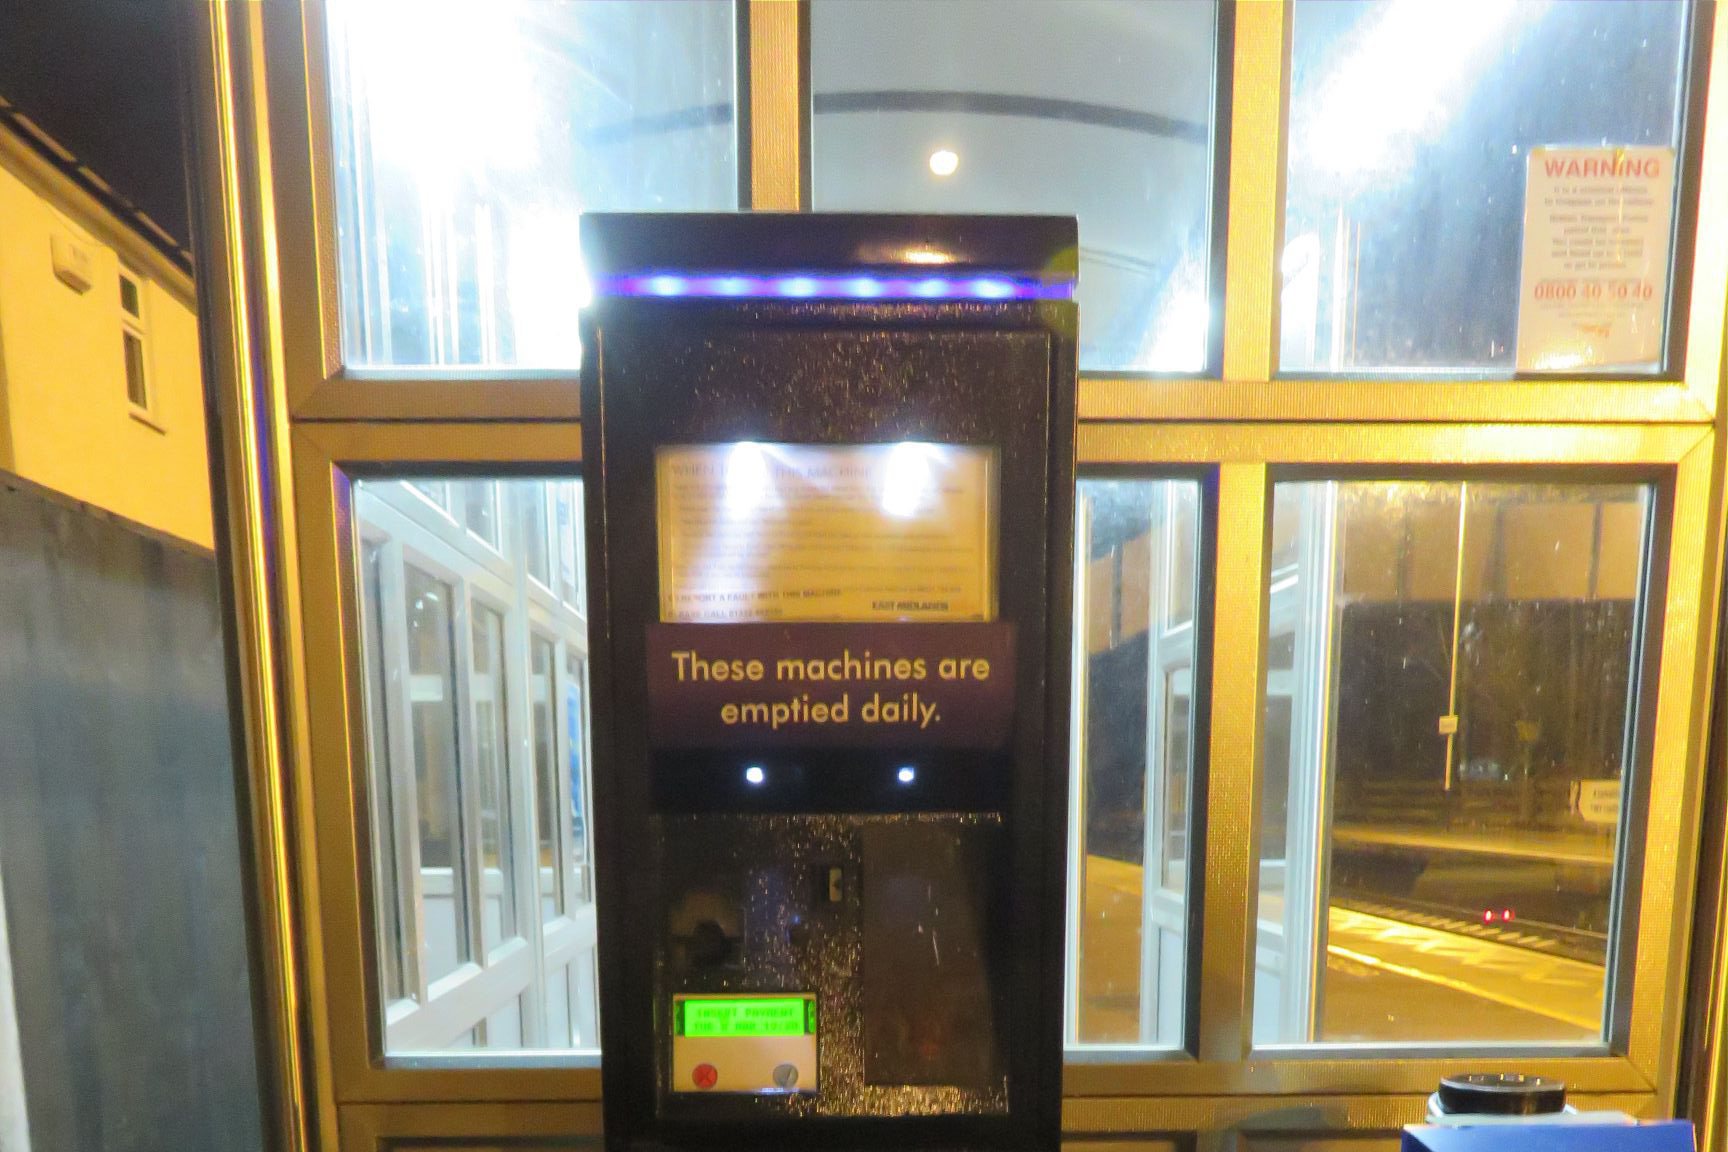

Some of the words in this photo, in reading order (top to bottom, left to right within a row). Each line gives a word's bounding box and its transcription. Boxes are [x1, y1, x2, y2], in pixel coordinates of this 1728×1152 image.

[1544, 158, 1660, 177] WARNING
[670, 650, 765, 682] These
[776, 648, 927, 682] machines
[937, 657, 991, 681] are
[720, 691, 850, 731] emptied
[860, 691, 942, 730] daily.
